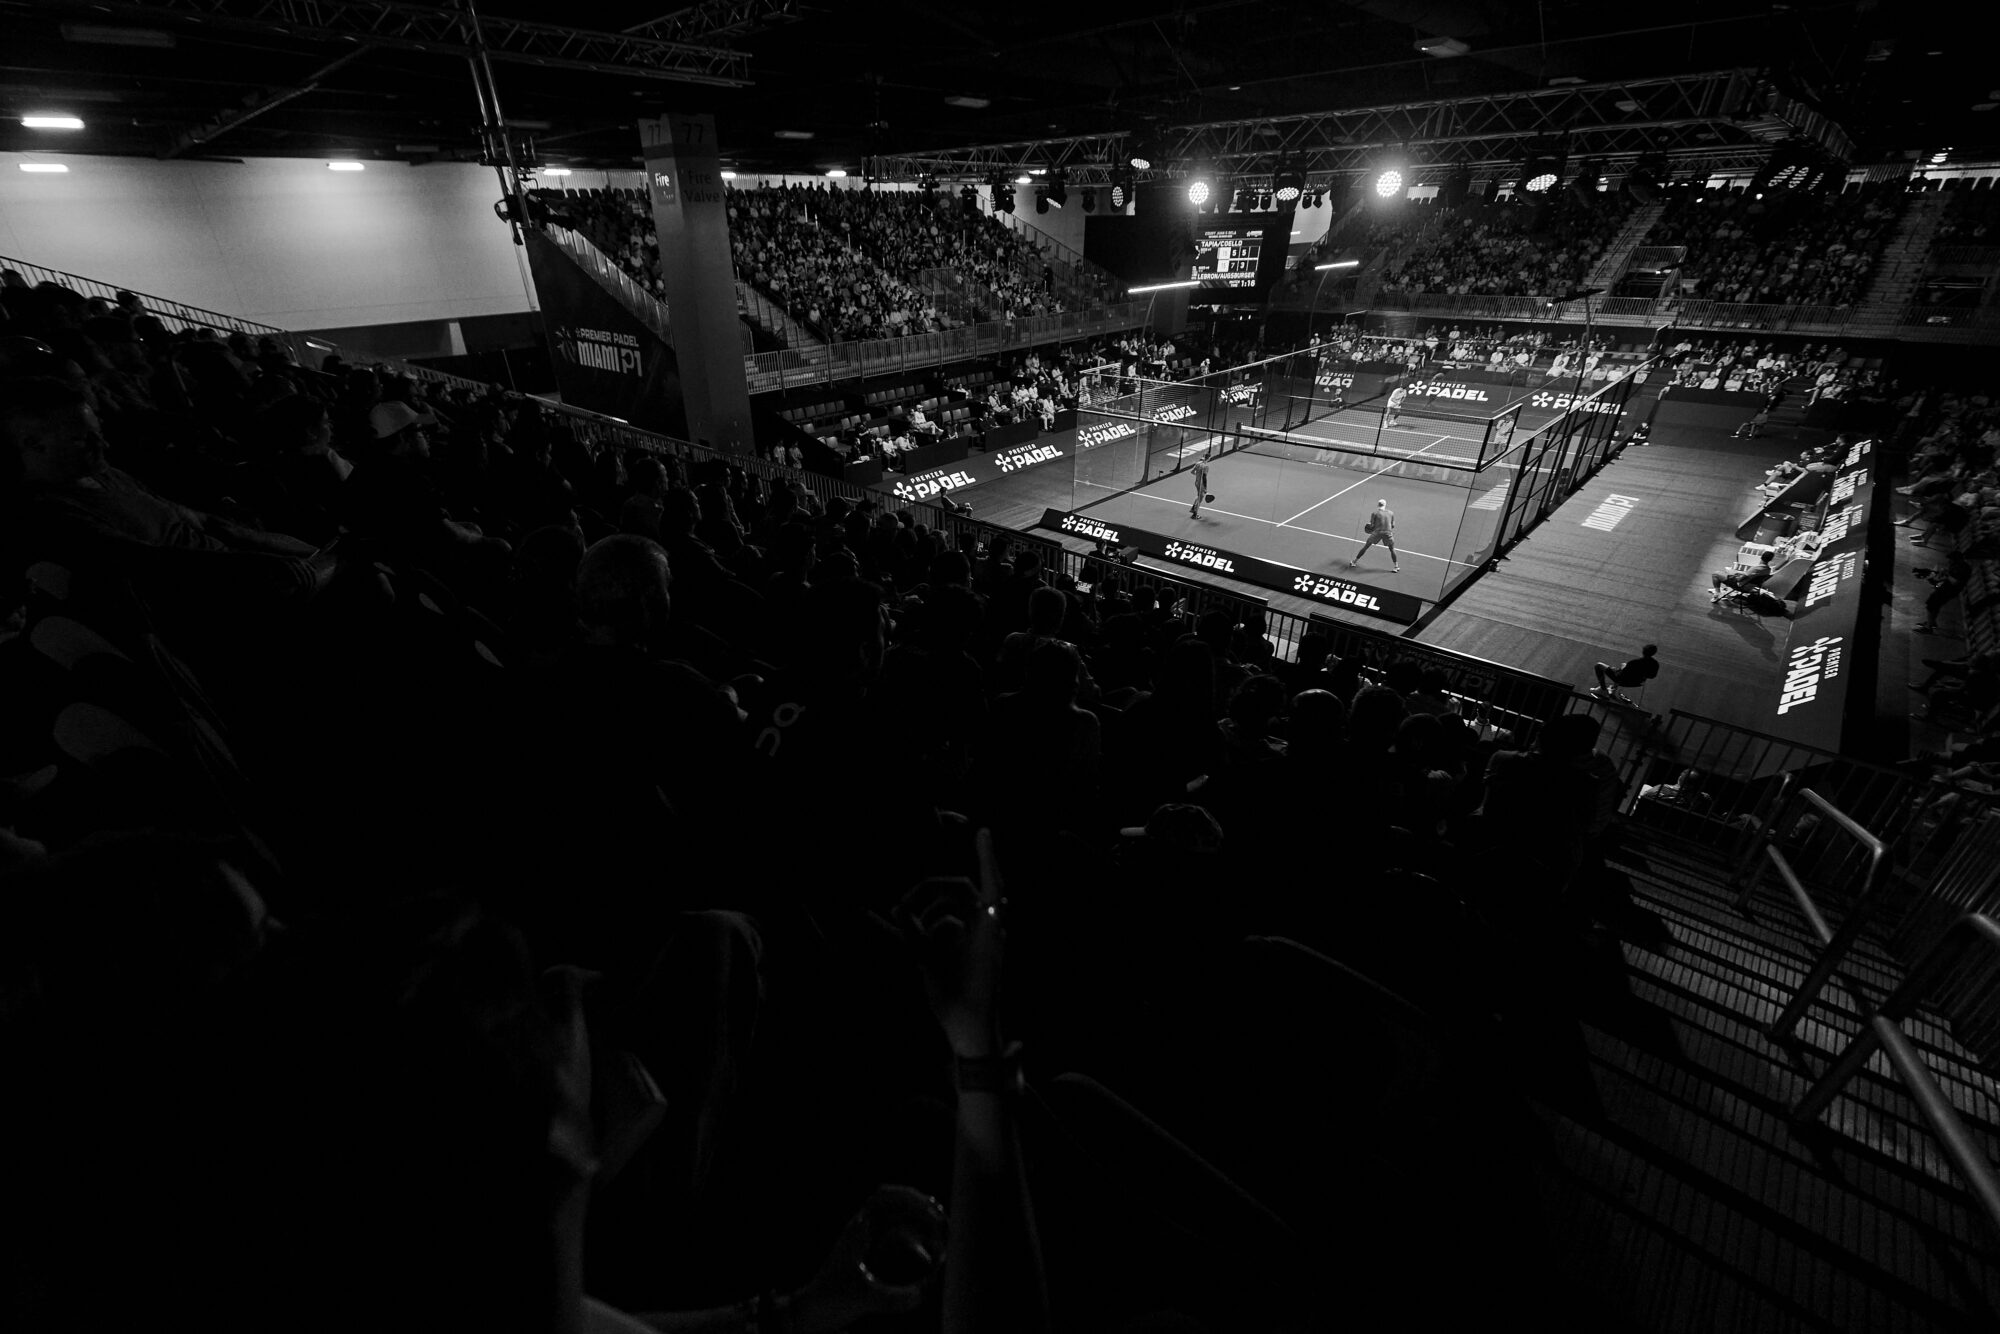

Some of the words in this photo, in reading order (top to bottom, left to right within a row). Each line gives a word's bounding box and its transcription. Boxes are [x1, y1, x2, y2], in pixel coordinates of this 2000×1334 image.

[681, 123, 703, 143] 77
[655, 172, 670, 187] Fire
[580, 327, 612, 343] PREMIER
[613, 331, 640, 348] PADEL
[577, 340, 621, 373] MIAMI
[620, 347, 643, 377] P1
[1425, 386, 1489, 402] PADEL
[1430, 381, 1467, 389] PREMIER
[1092, 423, 1136, 445] PADEL
[1007, 443, 1037, 456] PREMIER
[1012, 444, 1064, 469] PADEL
[910, 469, 945, 485] PREMIER
[914, 470, 977, 499] PADEL
[1074, 522, 1120, 543] PADEL
[1079, 517, 1106, 528] PREMIER
[1185, 544, 1218, 556] PREMIER
[1180, 550, 1235, 573] PADEL
[1318, 577, 1358, 592] PREMIER
[1804, 563, 1841, 608] PADEL
[1312, 582, 1381, 611] PADEL
[1824, 646, 1842, 680] PREMIER
[1776, 652, 1823, 716] PADEL
